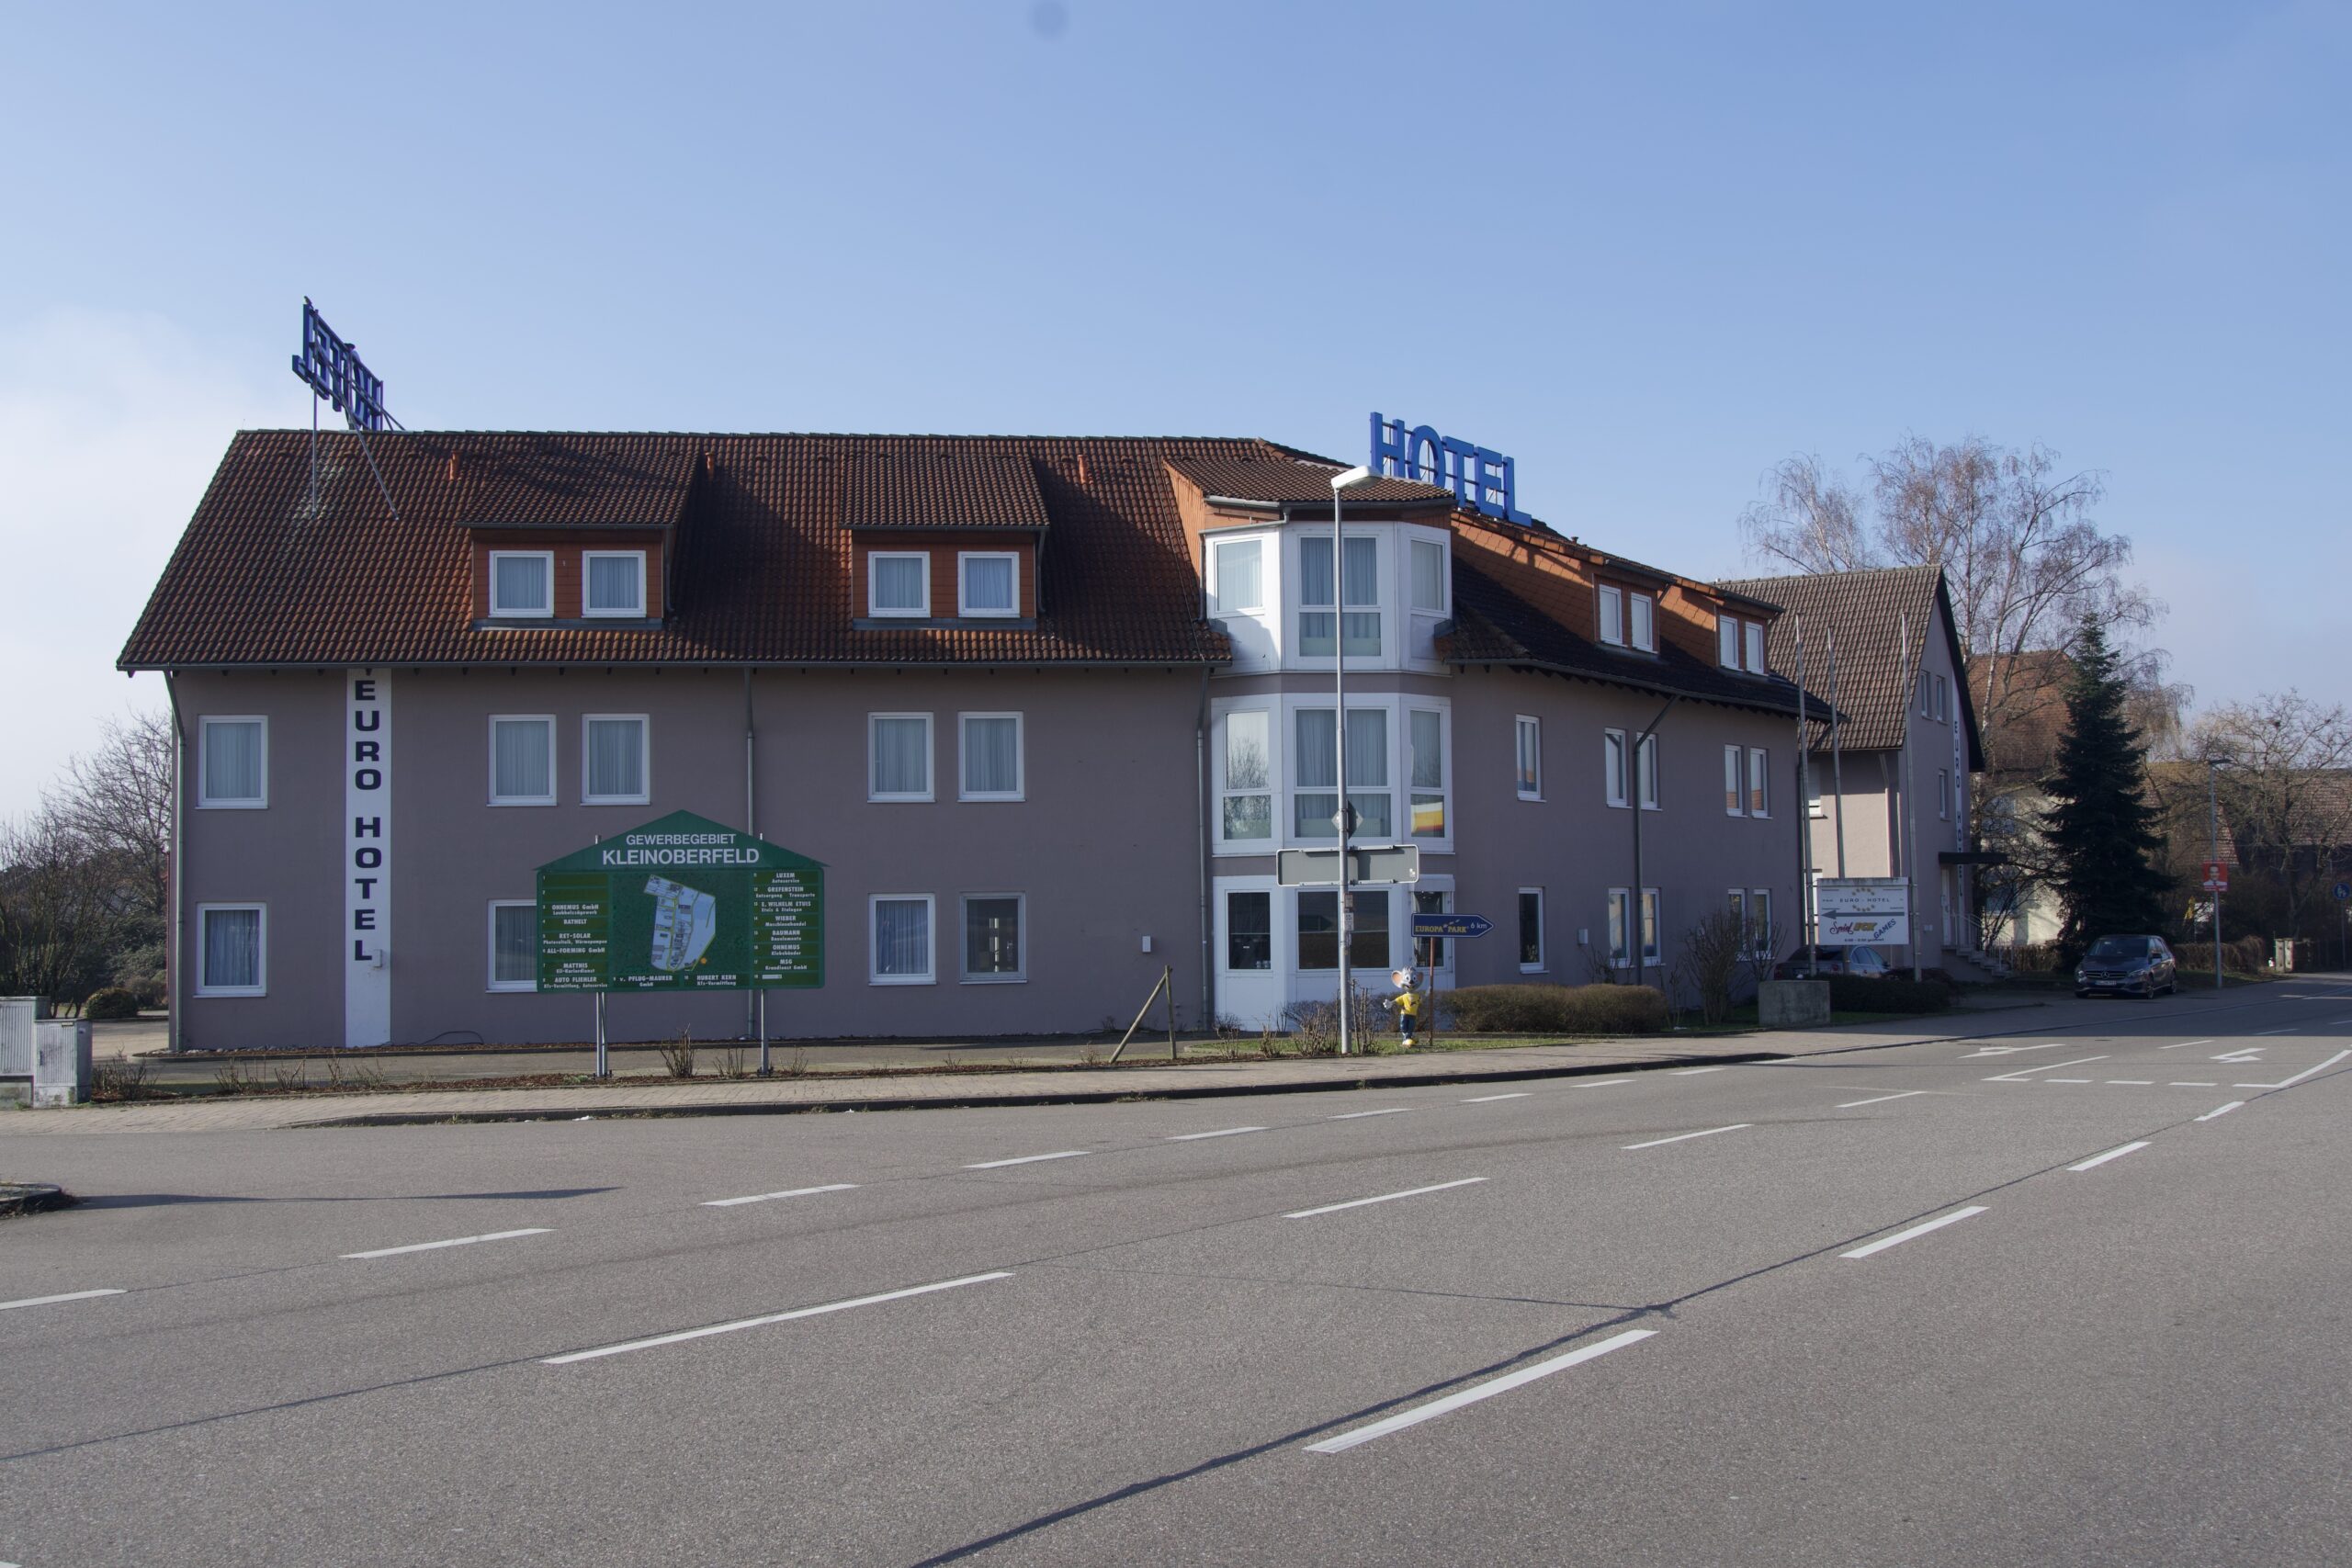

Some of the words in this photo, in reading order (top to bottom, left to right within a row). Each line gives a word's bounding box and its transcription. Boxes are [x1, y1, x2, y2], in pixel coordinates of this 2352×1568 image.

[1370, 412, 1532, 527] HOTEL
[355, 680, 381, 790] EURO
[603, 848, 760, 865] KLEINOBERFELD
[626, 833, 737, 845] GEWERBEGEBIET
[355, 817, 381, 962] HOTEL
[1873, 919, 1896, 939] GAMES
